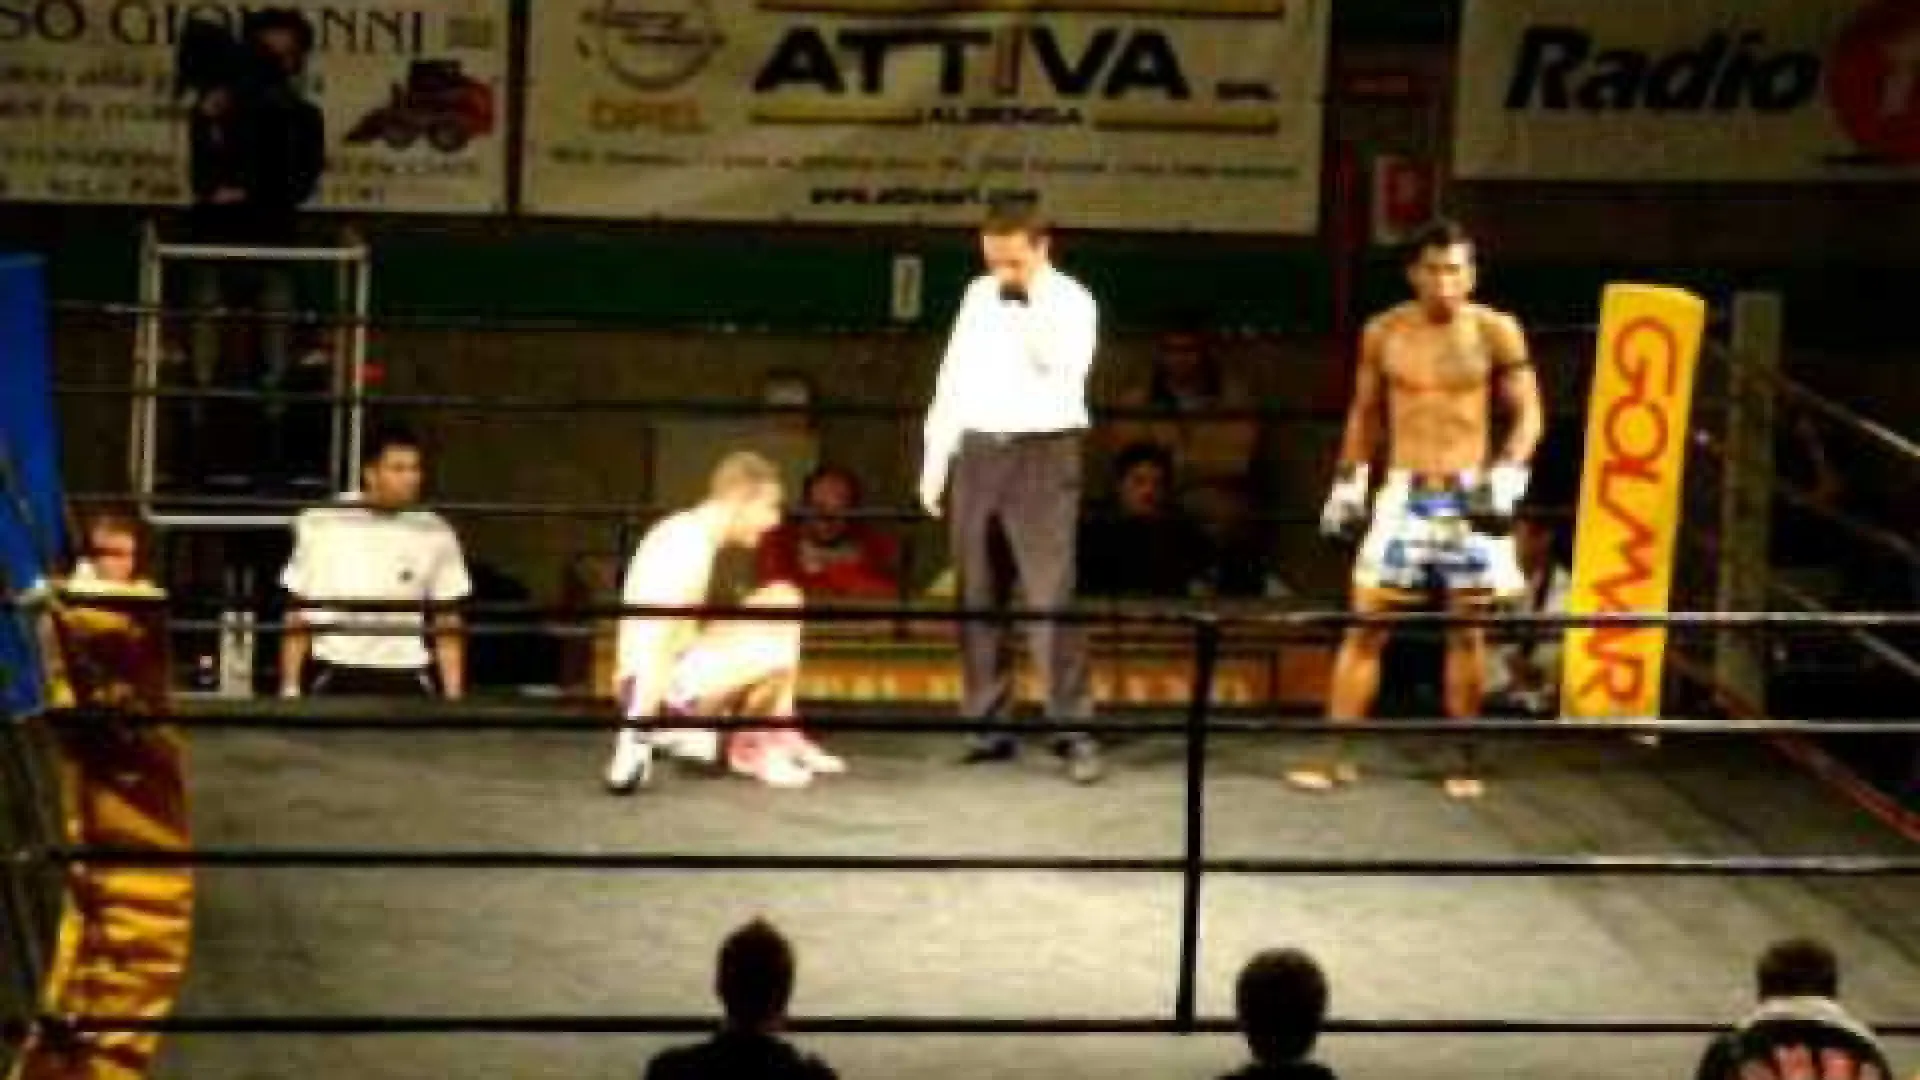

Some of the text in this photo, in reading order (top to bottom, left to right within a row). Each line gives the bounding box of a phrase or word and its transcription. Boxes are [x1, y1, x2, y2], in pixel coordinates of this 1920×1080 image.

[110, 2, 423, 53] GINNI
[753, 27, 1189, 98] ATTIVA
[1503, 27, 1822, 111] Radio
[589, 97, 708, 134] OPEL
